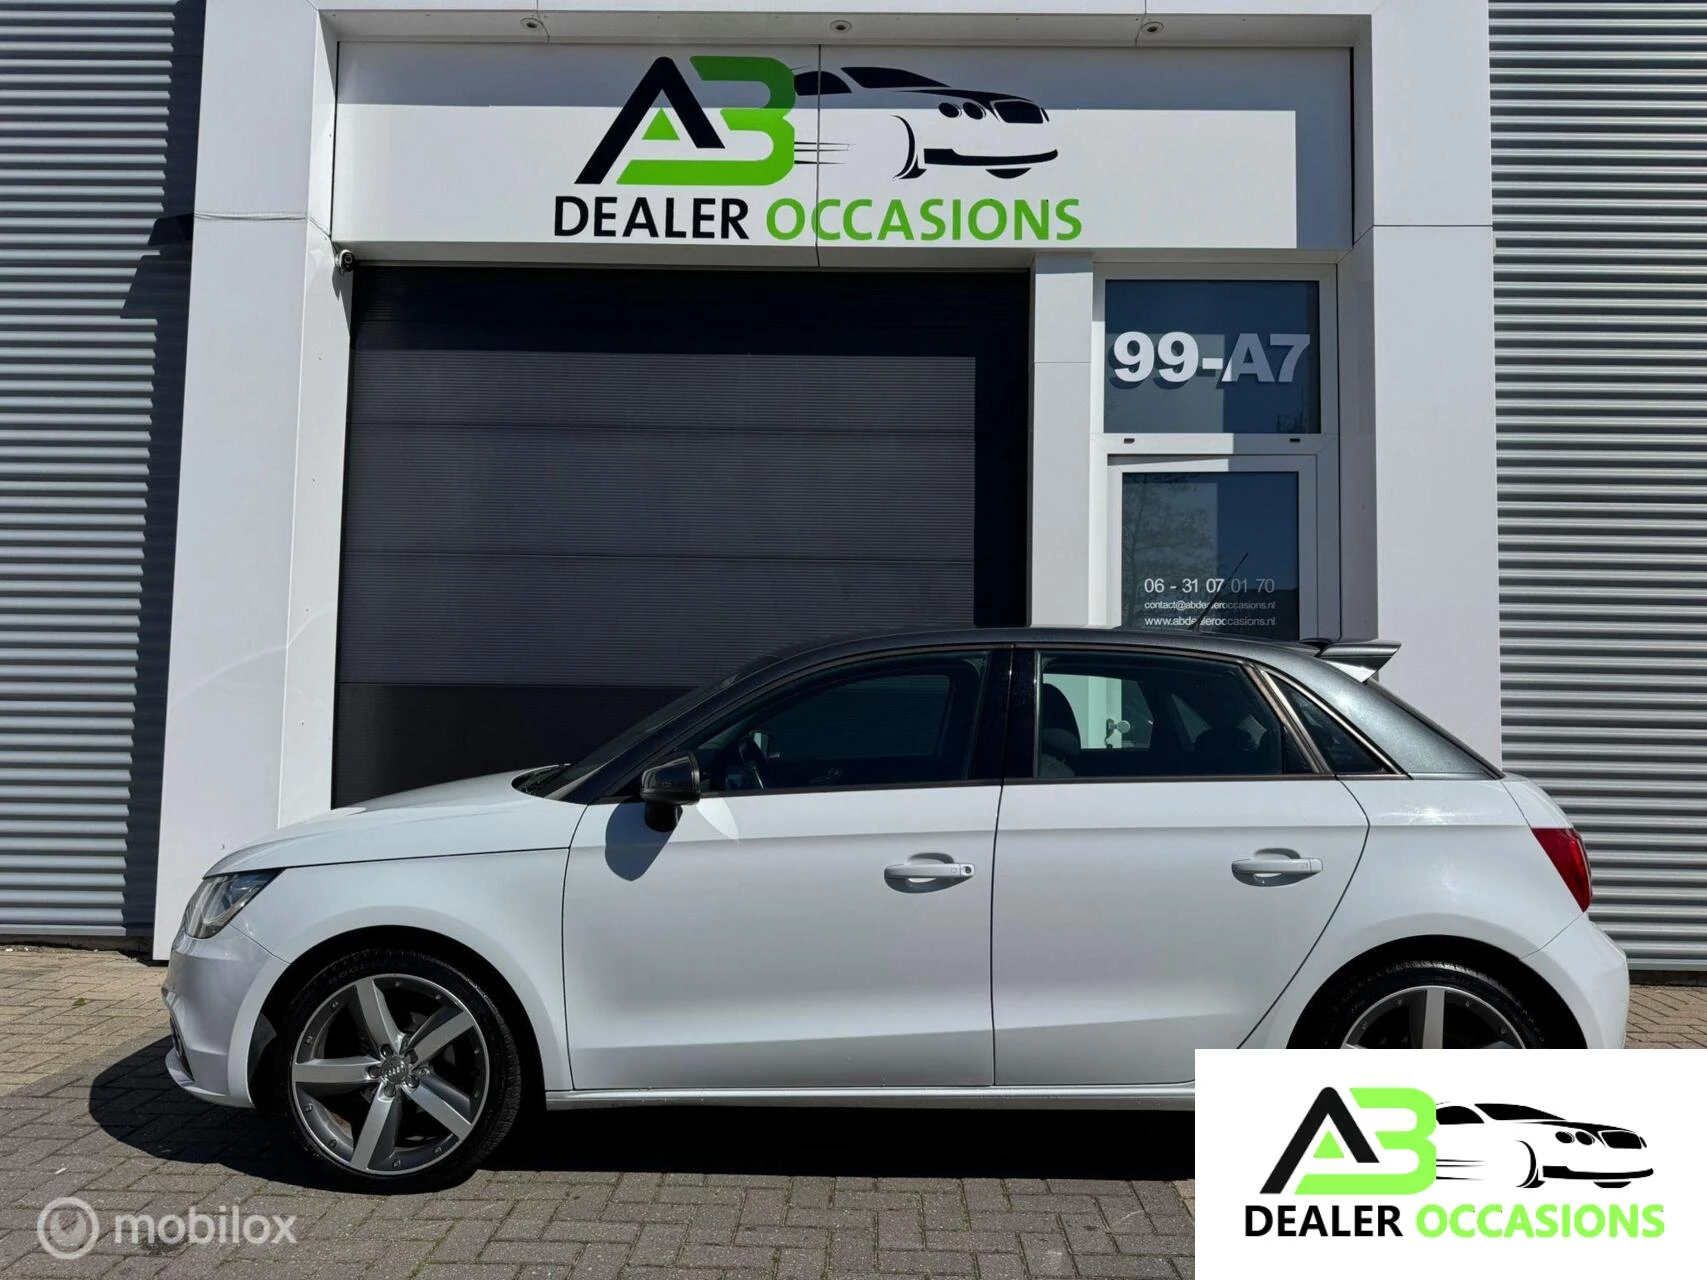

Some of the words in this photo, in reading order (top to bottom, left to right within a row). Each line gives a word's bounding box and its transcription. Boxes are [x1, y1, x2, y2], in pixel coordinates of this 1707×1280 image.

[554, 196, 749, 239] DEALER
[766, 198, 1082, 241] OCCASIONS
[1113, 331, 1310, 383] 99-A7
[1144, 578, 1165, 593] 06
[1182, 578, 1198, 593] 31
[1206, 578, 1224, 593] 07
[1231, 578, 1247, 593] 01
[1256, 578, 1275, 593] 70
